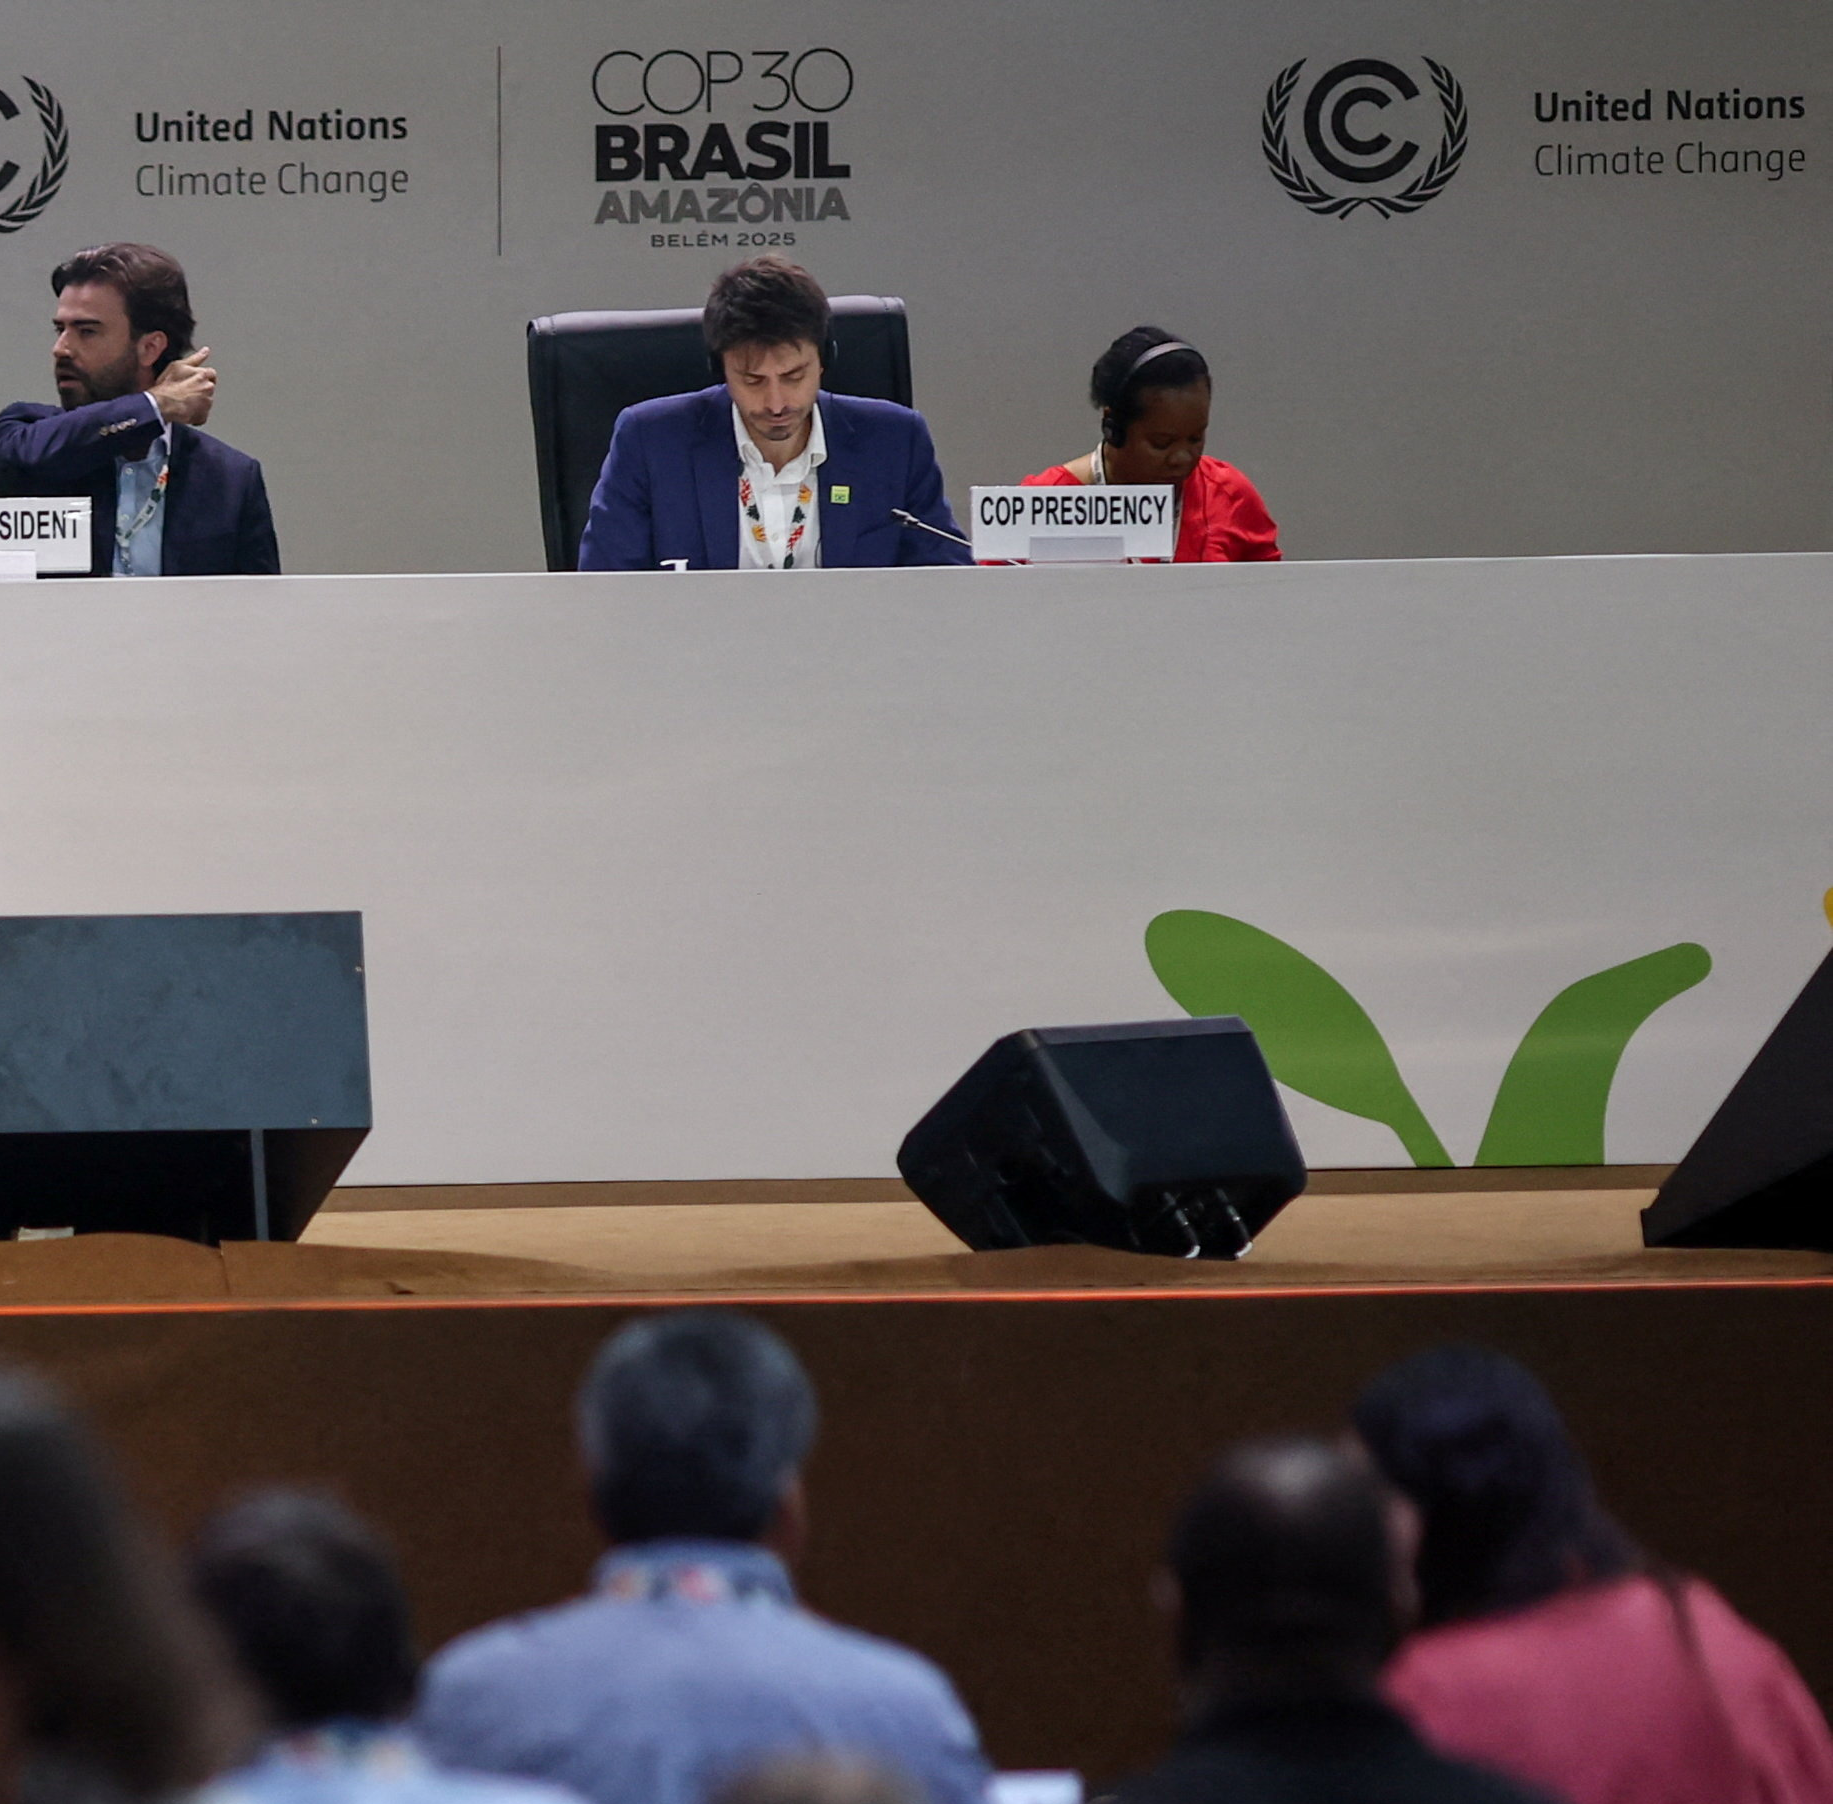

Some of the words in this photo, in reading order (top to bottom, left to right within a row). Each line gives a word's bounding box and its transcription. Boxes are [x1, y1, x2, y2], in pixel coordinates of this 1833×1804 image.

[1535, 89, 1651, 122] United
[1667, 88, 1804, 120] Nations
[136, 109, 252, 142] United
[269, 109, 407, 140] Nations
[596, 121, 850, 182] BRASIL
[1535, 144, 1664, 175] Climate
[1677, 141, 1805, 181] Change
[137, 164, 266, 196] Climate
[278, 162, 408, 202] Change
[595, 181, 851, 224] AMAZÔNIA
[651, 231, 728, 247] BELÉM
[737, 232, 796, 246] 2025
[981, 496, 1024, 525] COP
[1032, 496, 1166, 525] PRESIDENCY
